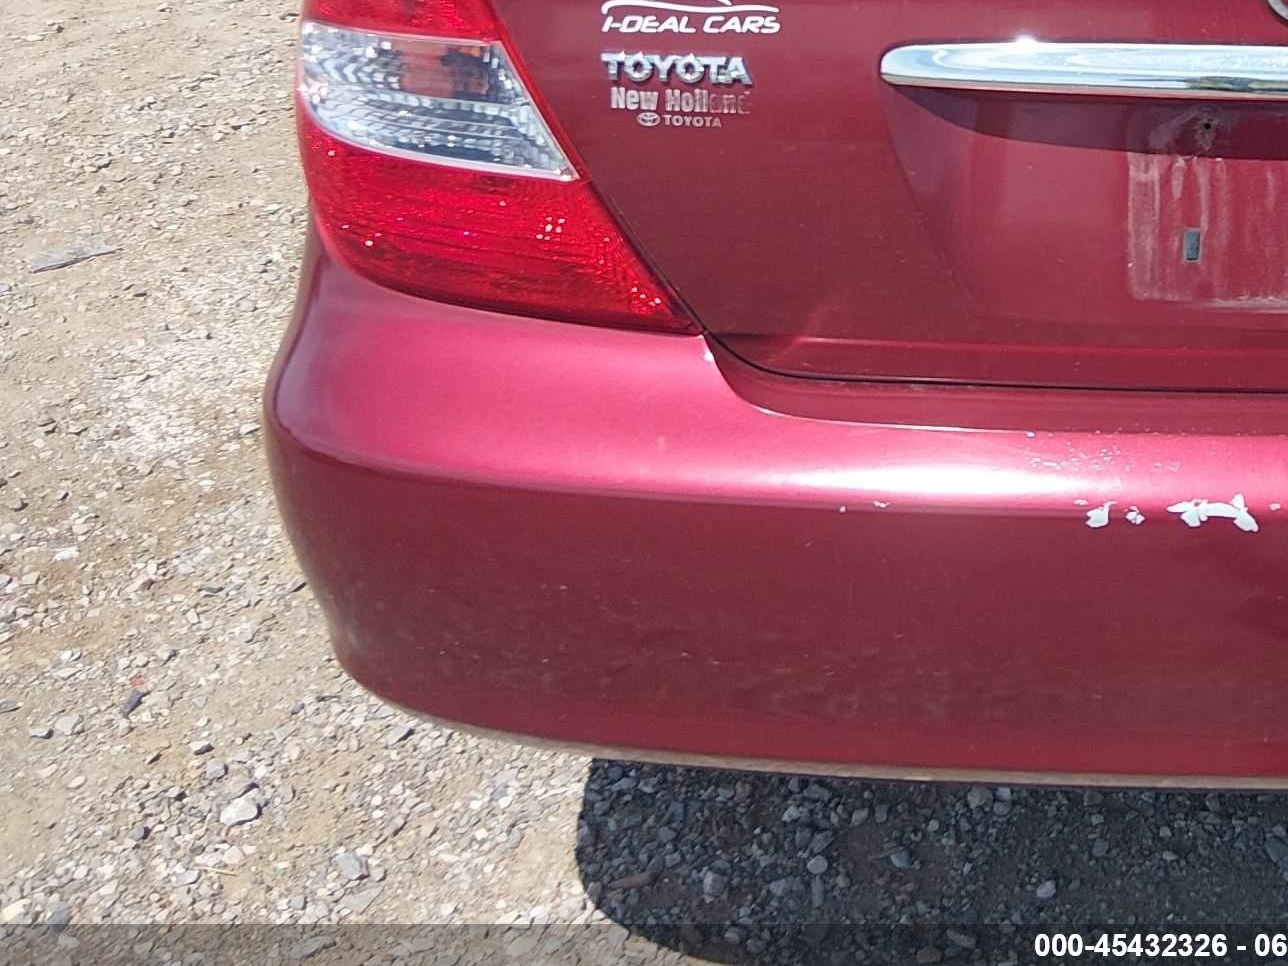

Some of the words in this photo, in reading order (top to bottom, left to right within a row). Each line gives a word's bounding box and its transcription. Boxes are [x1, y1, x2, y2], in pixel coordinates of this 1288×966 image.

[601, 15, 697, 33] I-DEAL
[702, 15, 781, 34] CARS
[600, 51, 753, 85] TOYOTA
[610, 87, 659, 111] New
[662, 114, 722, 128] TOYOTA
